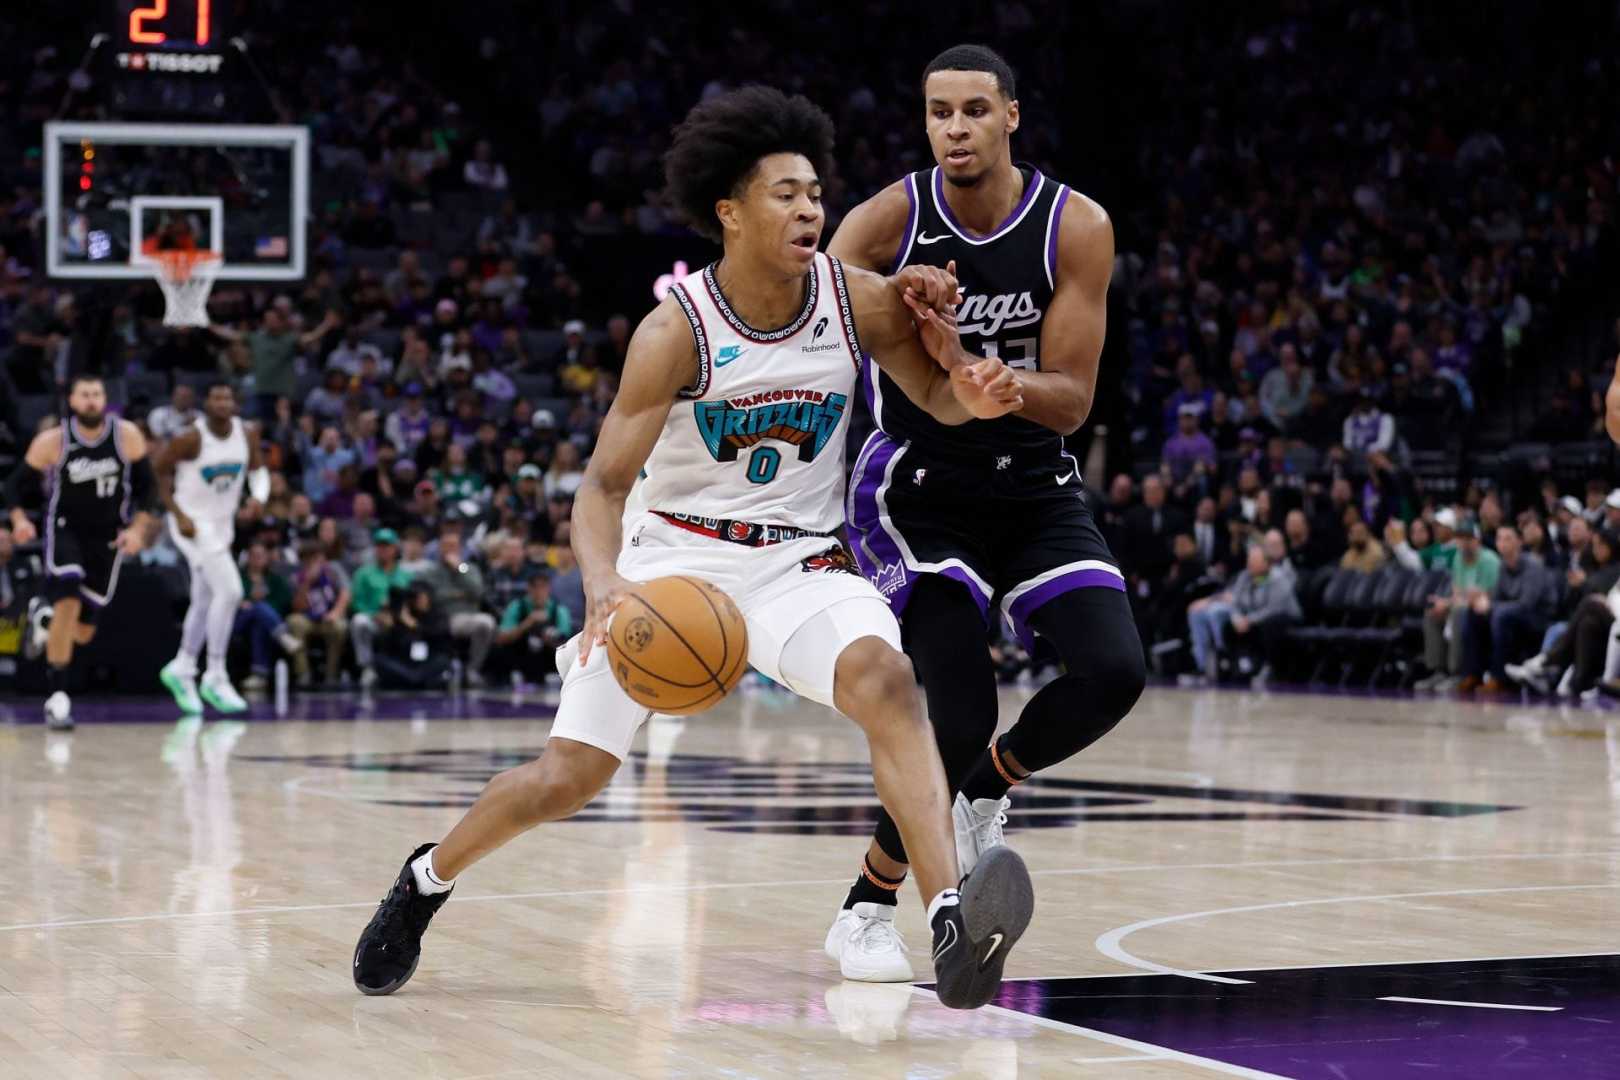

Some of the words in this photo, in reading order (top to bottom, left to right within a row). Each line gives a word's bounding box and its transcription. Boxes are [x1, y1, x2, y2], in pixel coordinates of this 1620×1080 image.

[146, 52, 223, 73] TISSOT
[952, 286, 1042, 337] ngs
[801, 342, 840, 354] Robinhood
[731, 389, 825, 408] VANCOUVER
[694, 391, 848, 463] GRIZZLIES
[746, 446, 782, 485] 0
[95, 475, 119, 498] 17
